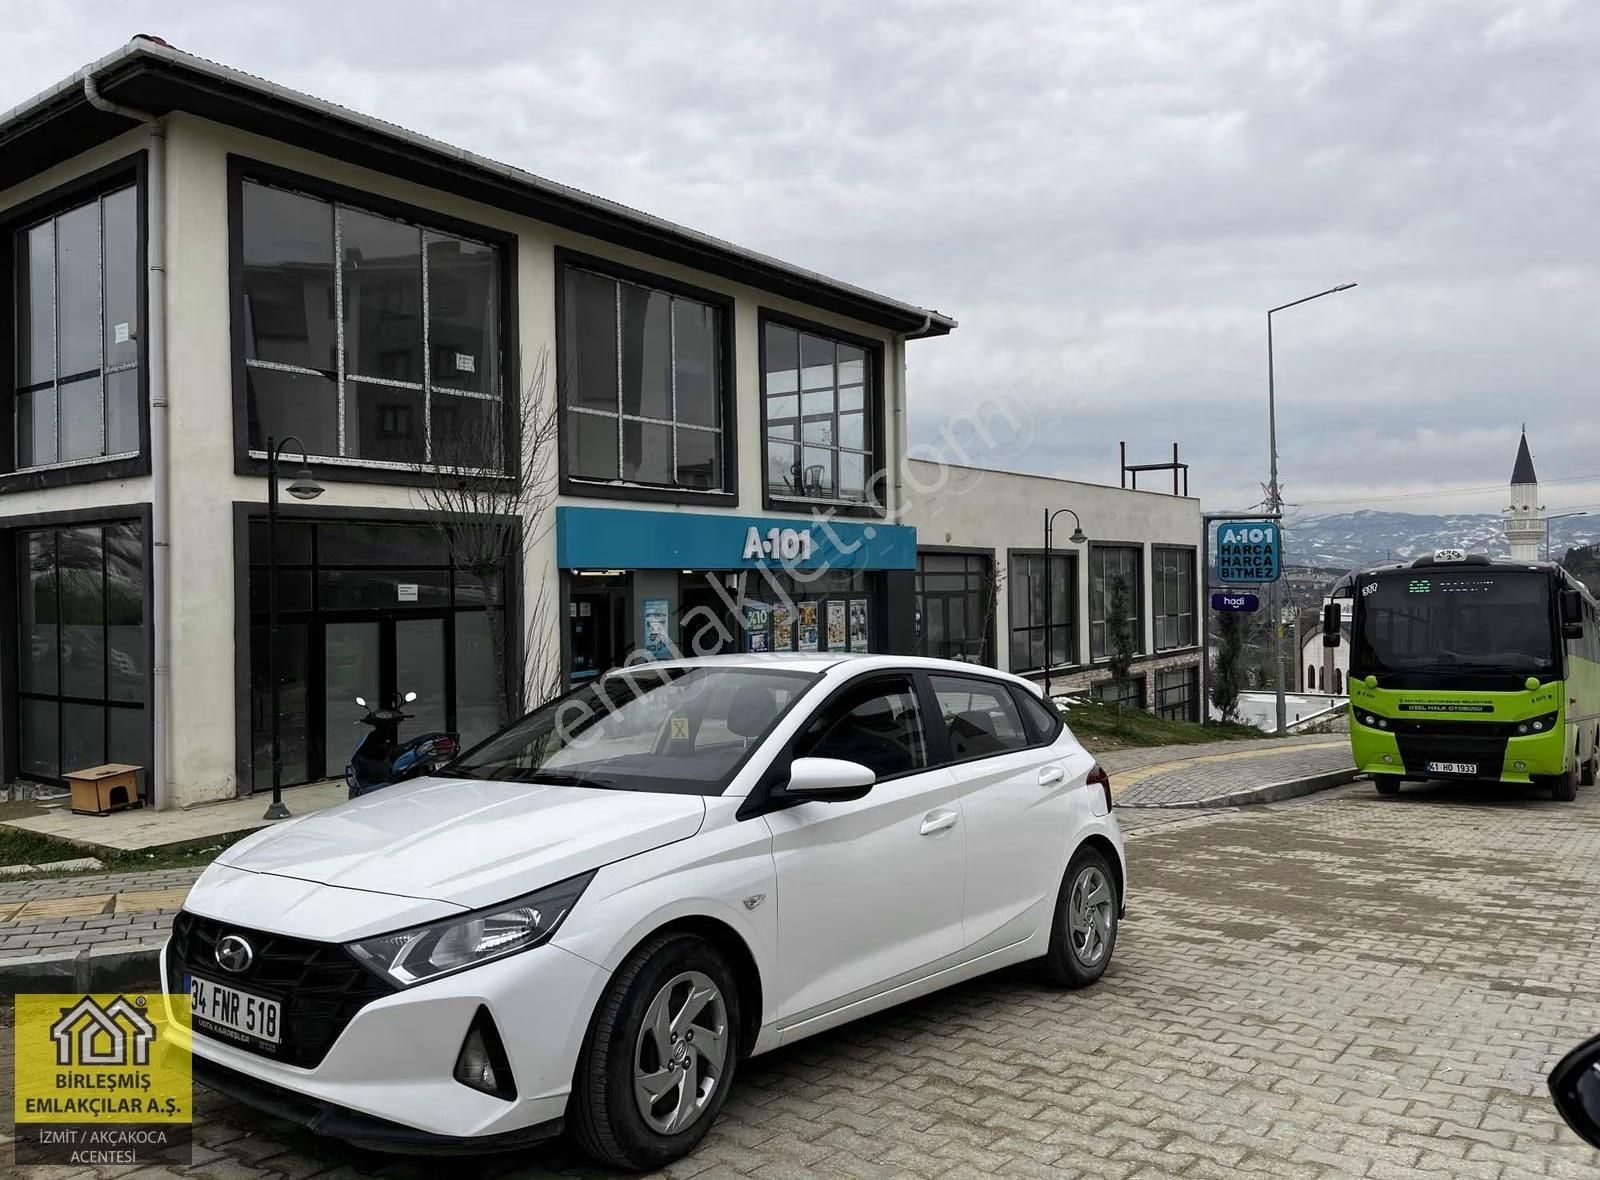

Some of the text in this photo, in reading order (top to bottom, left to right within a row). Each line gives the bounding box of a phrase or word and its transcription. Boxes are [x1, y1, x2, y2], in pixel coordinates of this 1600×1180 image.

[1221, 545, 1273, 555] HARCA
[1221, 556, 1273, 567] HARCA
[1223, 597, 1245, 605] hadi
[748, 610, 768, 625] %10
[1430, 762, 1439, 771] 41
[1457, 764, 1475, 773] 1933
[191, 979, 277, 1038] 34 FNR 518
[198, 1019, 213, 1031] USTA
